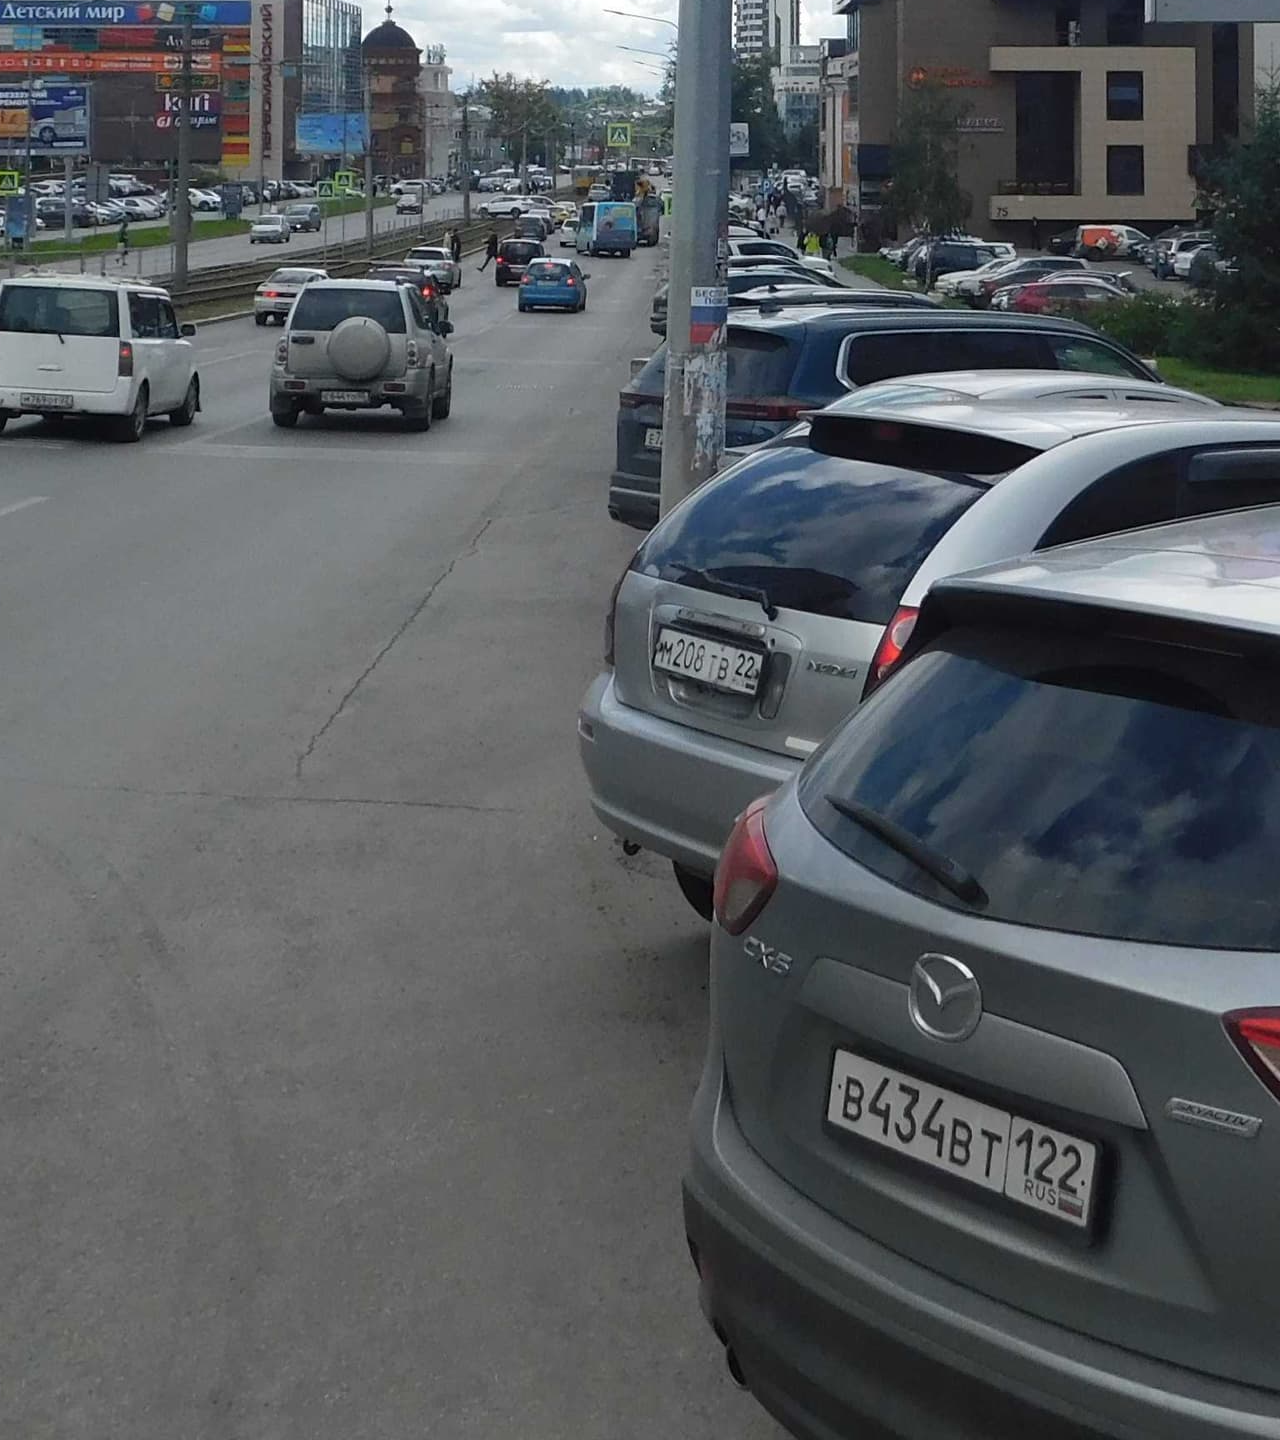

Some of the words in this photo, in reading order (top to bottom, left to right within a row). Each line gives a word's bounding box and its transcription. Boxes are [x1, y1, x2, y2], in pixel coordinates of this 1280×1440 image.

[1, 3, 81, 20] Детский
[85, 6, 126, 22] мир
[164, 56, 212, 69] DS
[261, 3, 273, 159] ПЕРВОМАЙСКИЙ
[841, 1075, 1002, 1178] В434ВТ
[1015, 1127, 1082, 1195] 122
[1023, 1179, 1057, 1206] RUS
